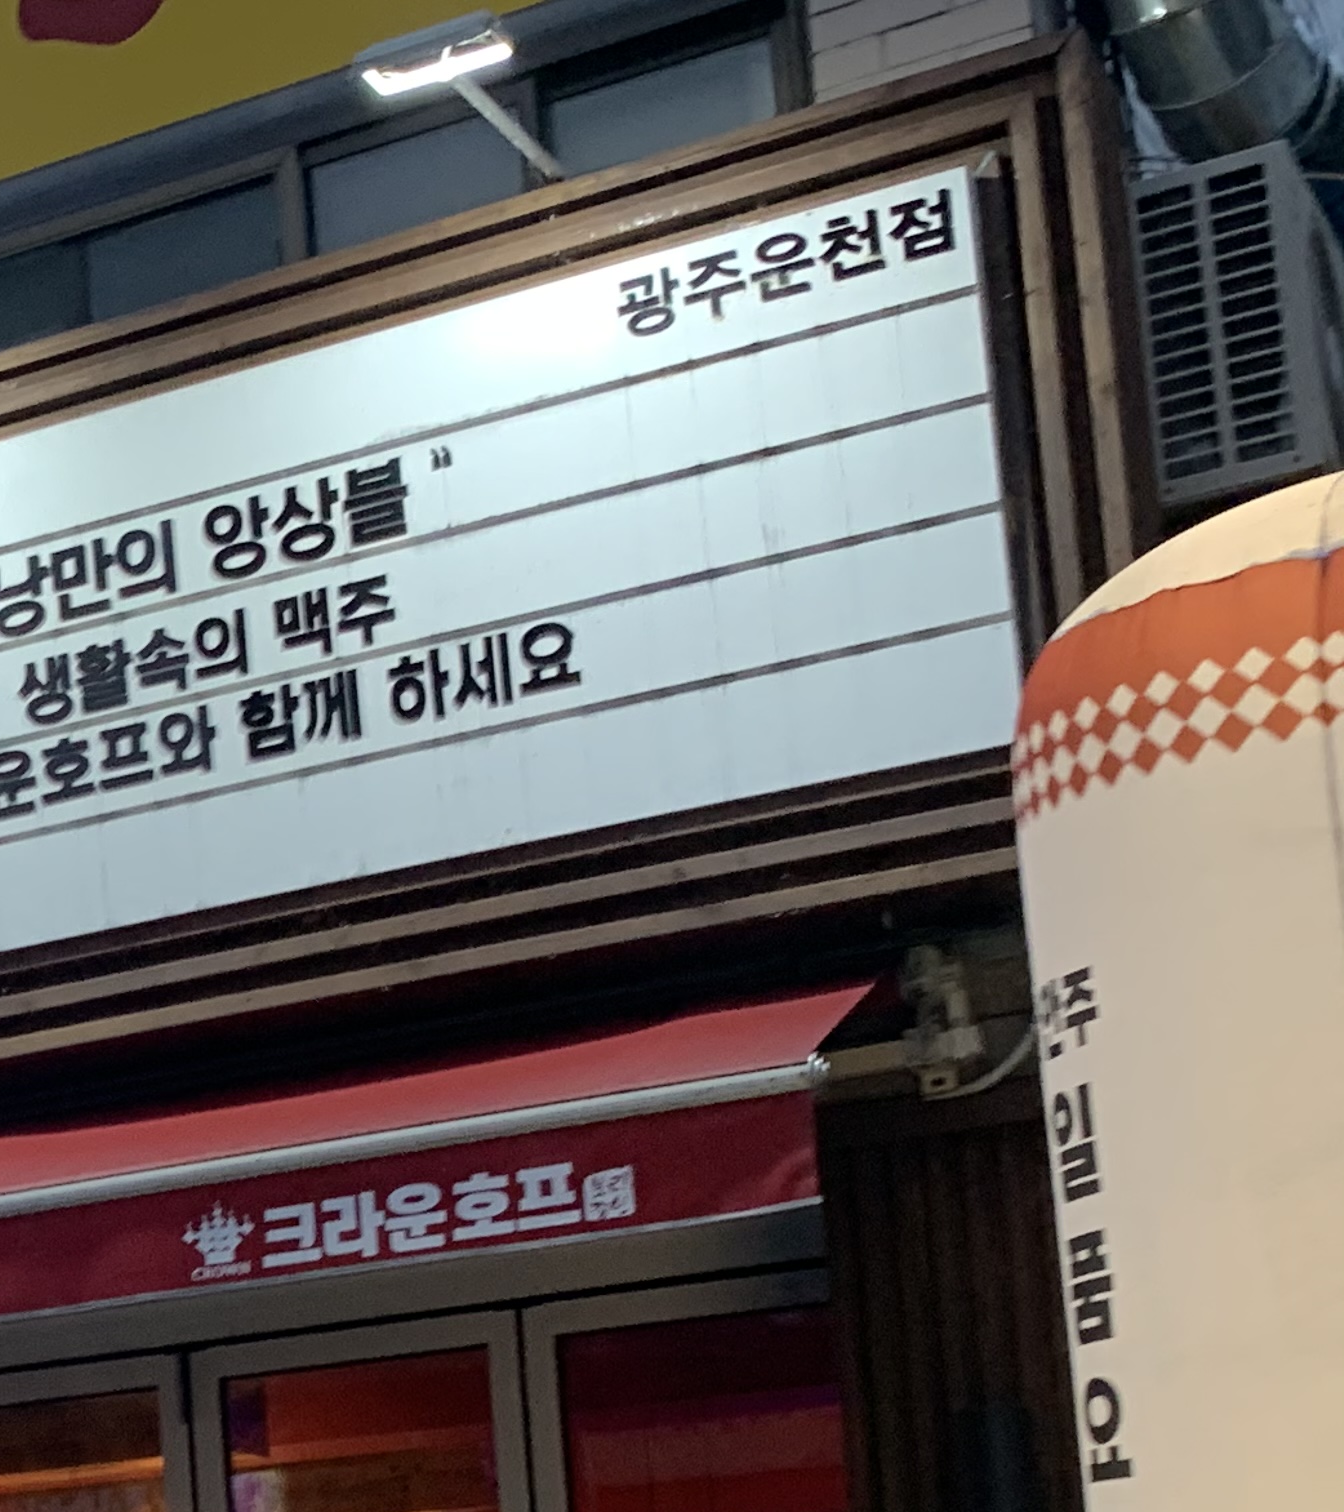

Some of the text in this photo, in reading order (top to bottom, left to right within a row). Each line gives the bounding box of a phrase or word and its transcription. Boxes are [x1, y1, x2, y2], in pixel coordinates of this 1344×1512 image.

[616, 190, 955, 335] 광주운천점
[16, 575, 398, 726] 생활속의 맥주
[240, 674, 363, 757] 함께
[388, 621, 583, 723] 하세요
[262, 1161, 582, 1268] 크라운호프
